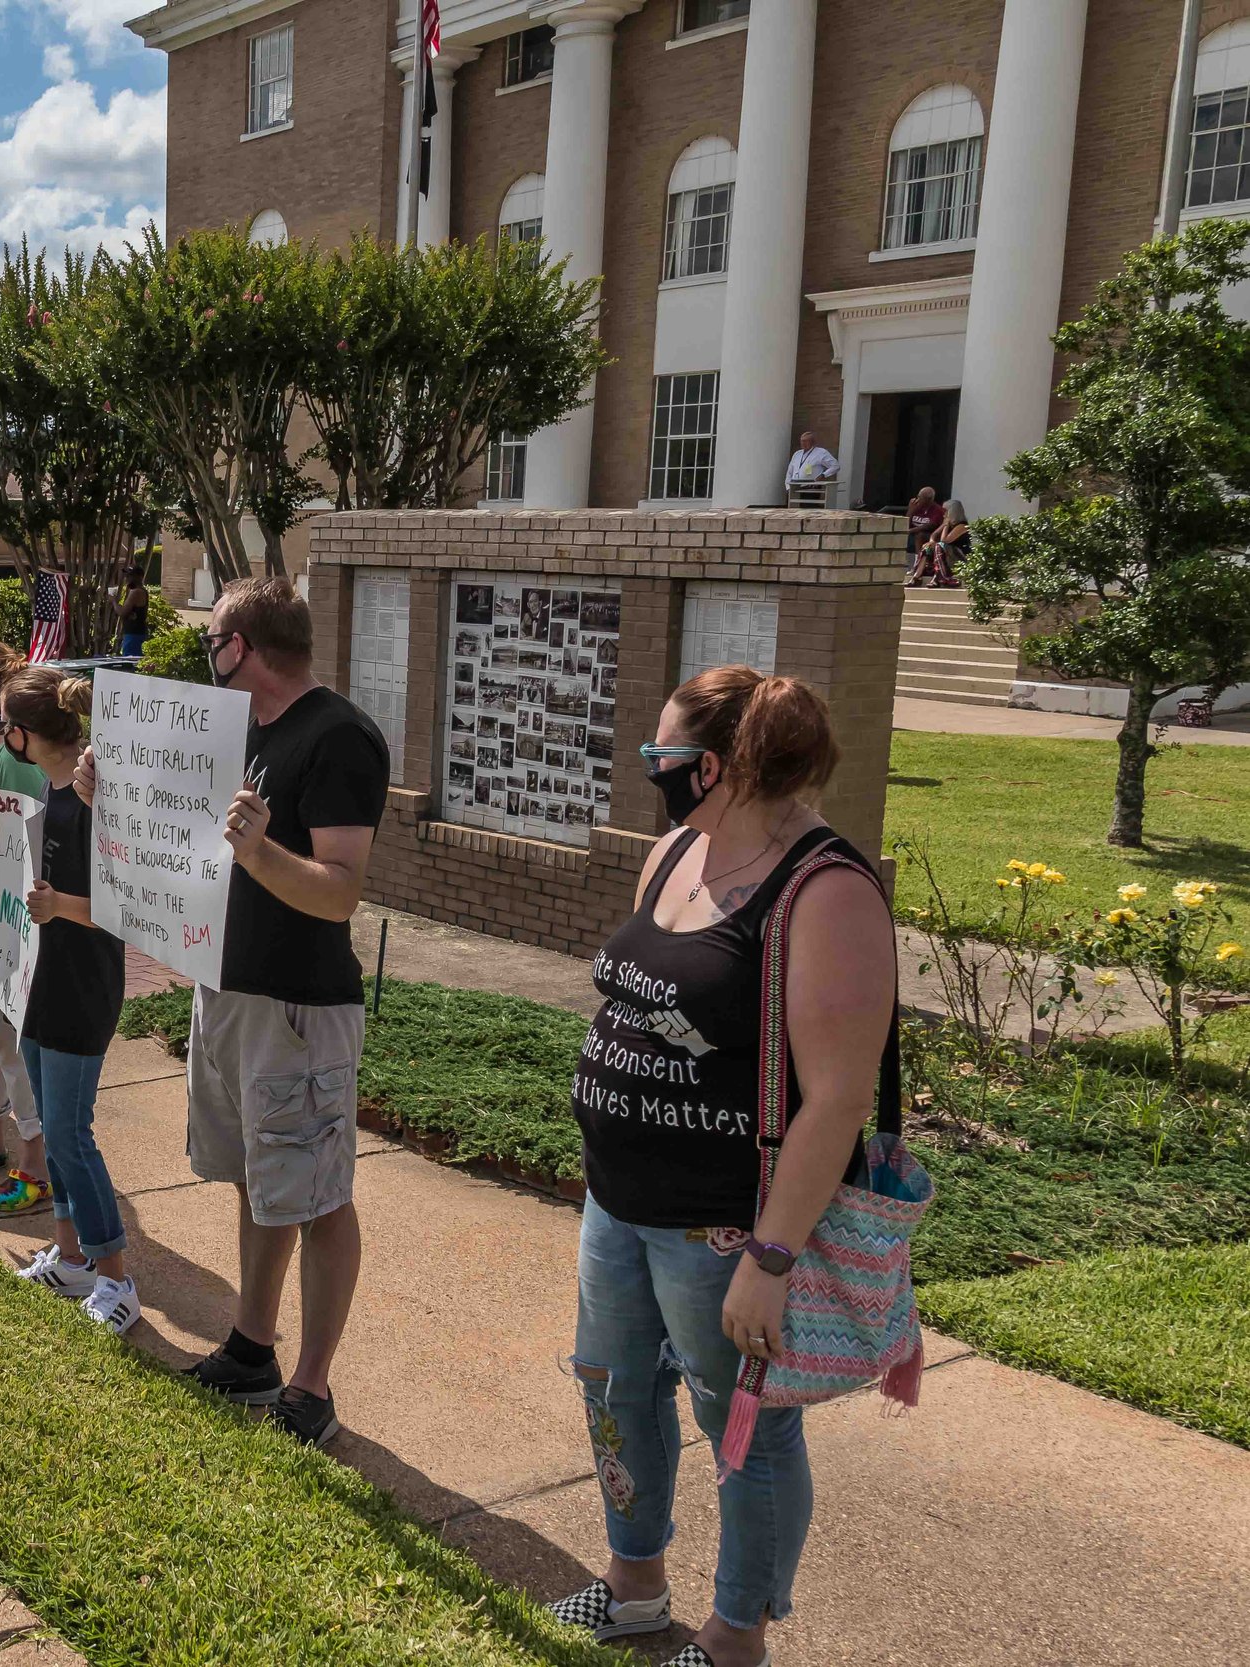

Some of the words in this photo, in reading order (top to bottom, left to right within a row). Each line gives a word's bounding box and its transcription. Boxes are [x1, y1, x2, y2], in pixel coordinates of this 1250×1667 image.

[101, 691, 120, 722] WE
[129, 692, 165, 723] MUST
[170, 701, 210, 733] TAKE
[96, 733, 124, 765] SIDES.
[131, 740, 214, 790] NEUTRALITY
[97, 776, 118, 800] HELPS
[124, 782, 140, 802] THE
[146, 784, 218, 824] OPPRESSOR,
[98, 804, 120, 830] NEVER
[126, 814, 142, 838] THE
[148, 818, 196, 851] VICTIM.
[98, 832, 130, 864] SILENCE
[135, 846, 192, 875] ENCOURAGES
[202, 860, 219, 880] THE
[98, 864, 140, 908] TORMENTOR,
[142, 886, 158, 906] NOT
[164, 893, 184, 914] THE
[0, 888, 32, 950] MATTER
[183, 924, 210, 950] BLM
[582, 1076, 630, 1118] Lives
[641, 1095, 750, 1136] Matter
